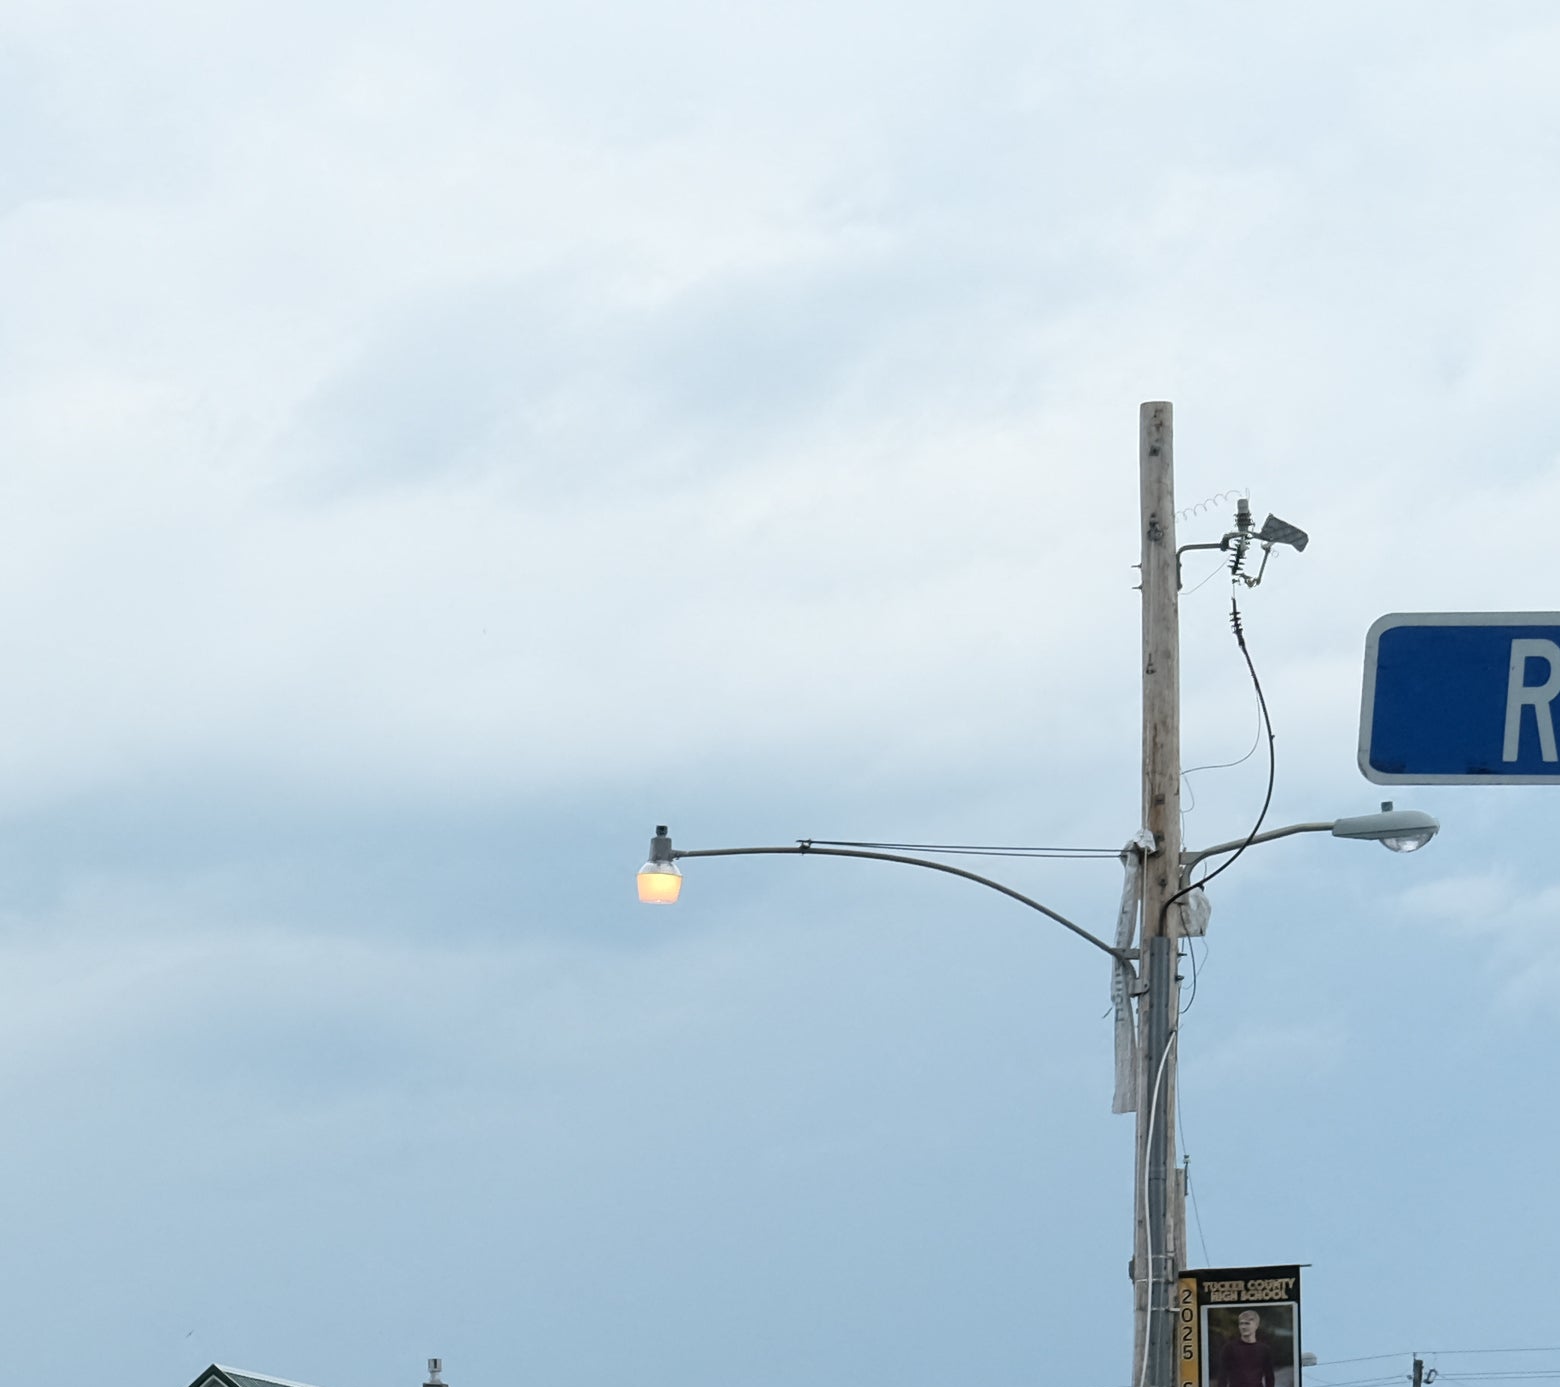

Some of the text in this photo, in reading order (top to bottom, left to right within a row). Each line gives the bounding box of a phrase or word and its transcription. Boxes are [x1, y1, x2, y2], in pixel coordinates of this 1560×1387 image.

[1203, 1278, 1295, 1294] TUCKER COUNTY
[1210, 1289, 1288, 1302] HIGH SCHOOL
